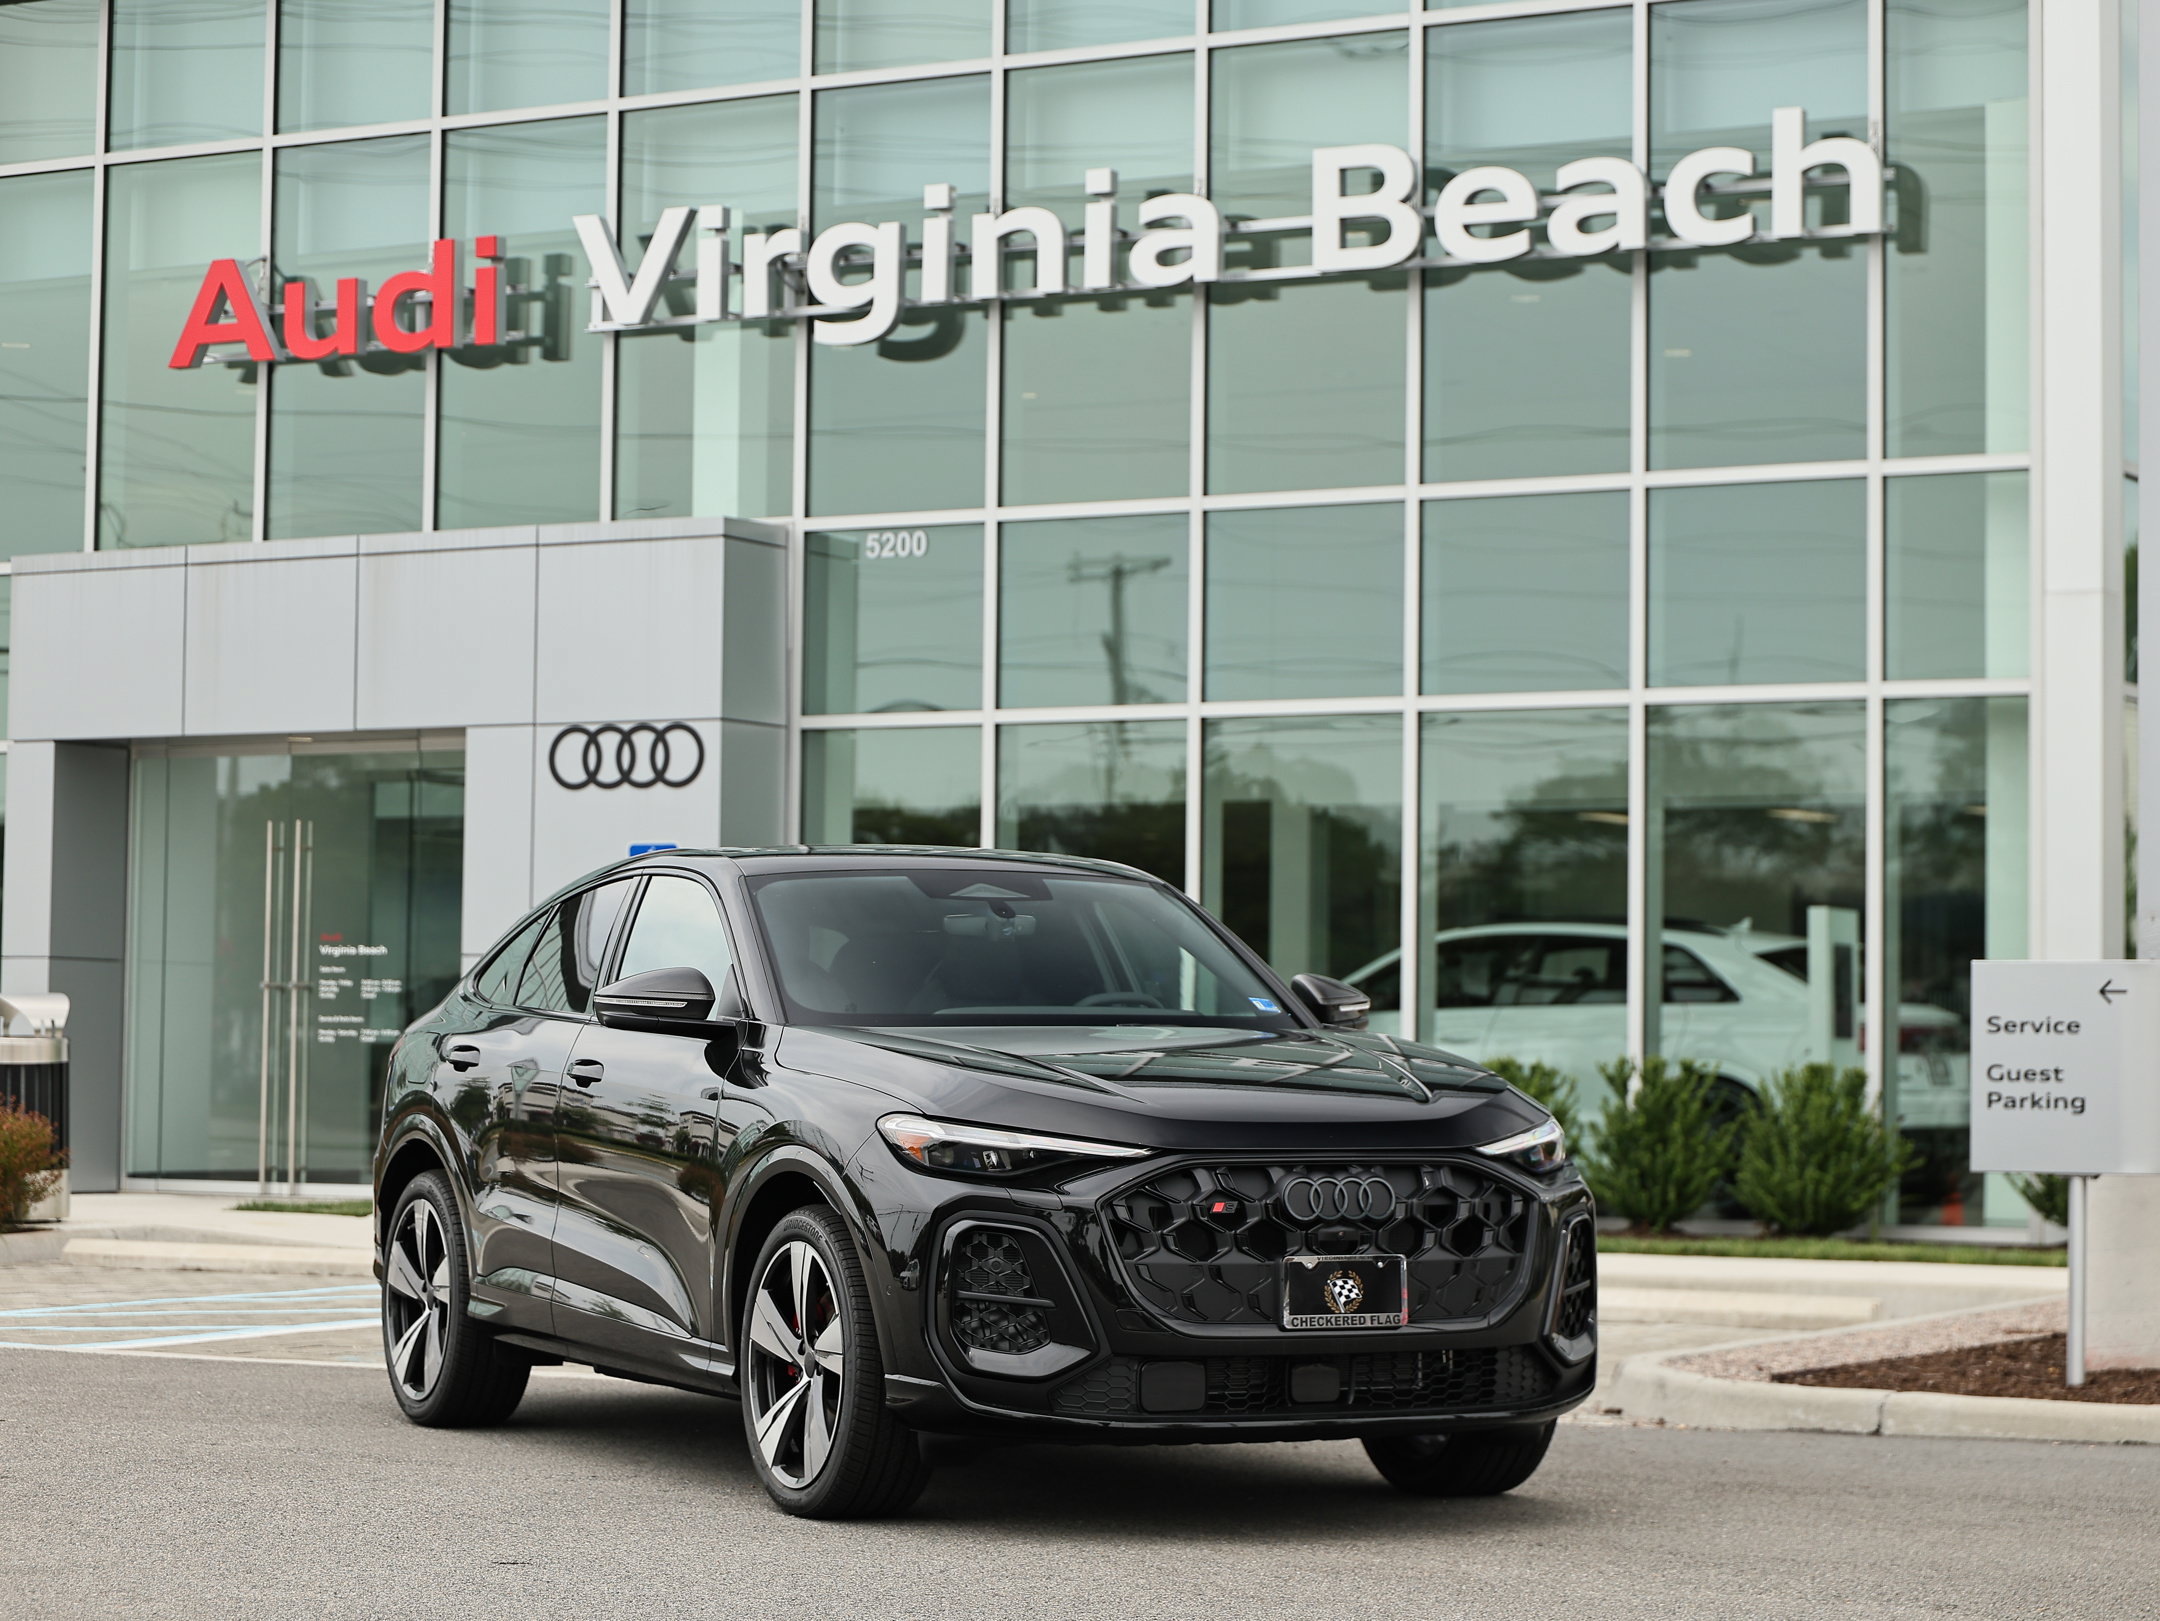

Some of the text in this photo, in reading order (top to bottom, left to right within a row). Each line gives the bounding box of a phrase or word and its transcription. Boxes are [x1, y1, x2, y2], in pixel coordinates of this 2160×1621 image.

[169, 107, 1883, 369] Audi Virginia Beach
[865, 530, 928, 559] 5200
[1987, 1016, 2081, 1035] Service
[1987, 1064, 2065, 1082] Guest
[1987, 1092, 2086, 1115] Parking
[1291, 1314, 1401, 1328] CHECKERED FLAG
